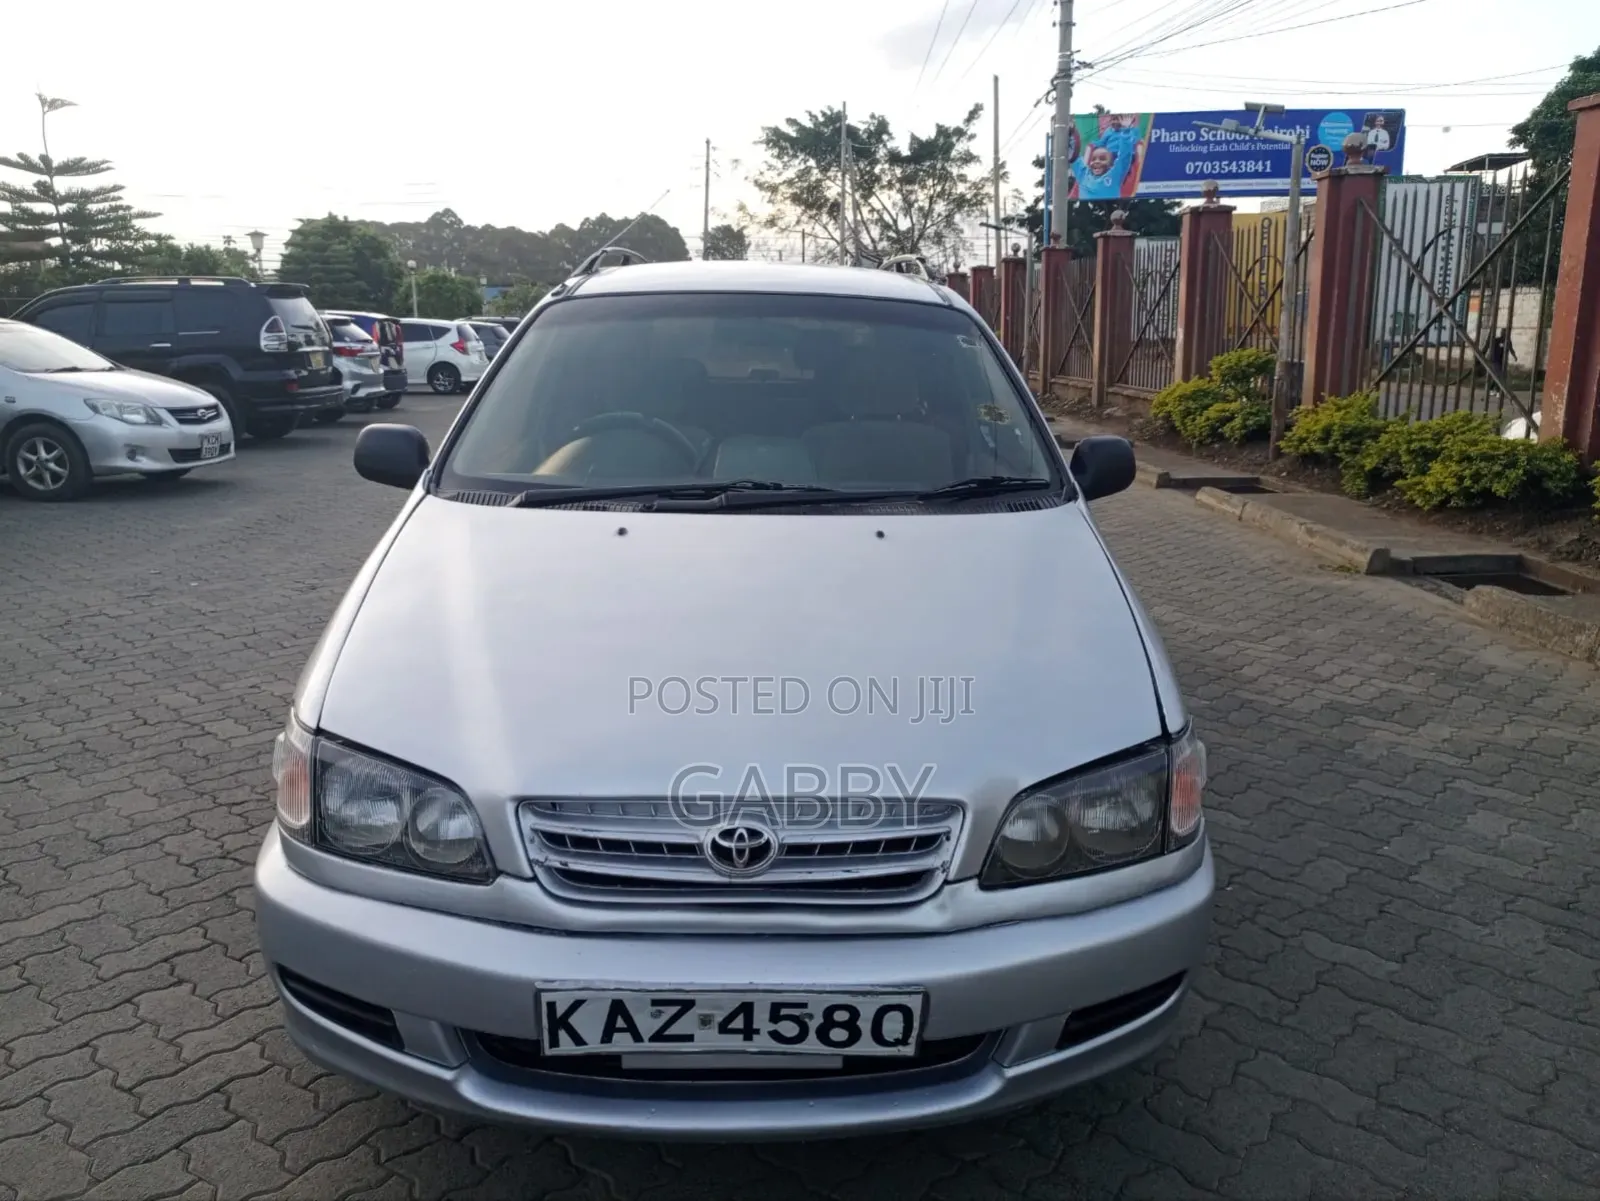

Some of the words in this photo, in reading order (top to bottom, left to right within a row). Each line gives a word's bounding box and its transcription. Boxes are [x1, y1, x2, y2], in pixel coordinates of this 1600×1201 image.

[1151, 128, 1196, 143] Pharo
[1200, 126, 1250, 141] Schoo
[1169, 144, 1208, 154] Unlocking
[1209, 143, 1228, 152] Each
[1229, 142, 1255, 151] Child's
[1256, 141, 1291, 150] Potential
[1185, 160, 1272, 174] 0703543841
[1311, 159, 1329, 167] NOW
[546, 998, 697, 1049] KAZ
[716, 1001, 916, 1049] 458Q
